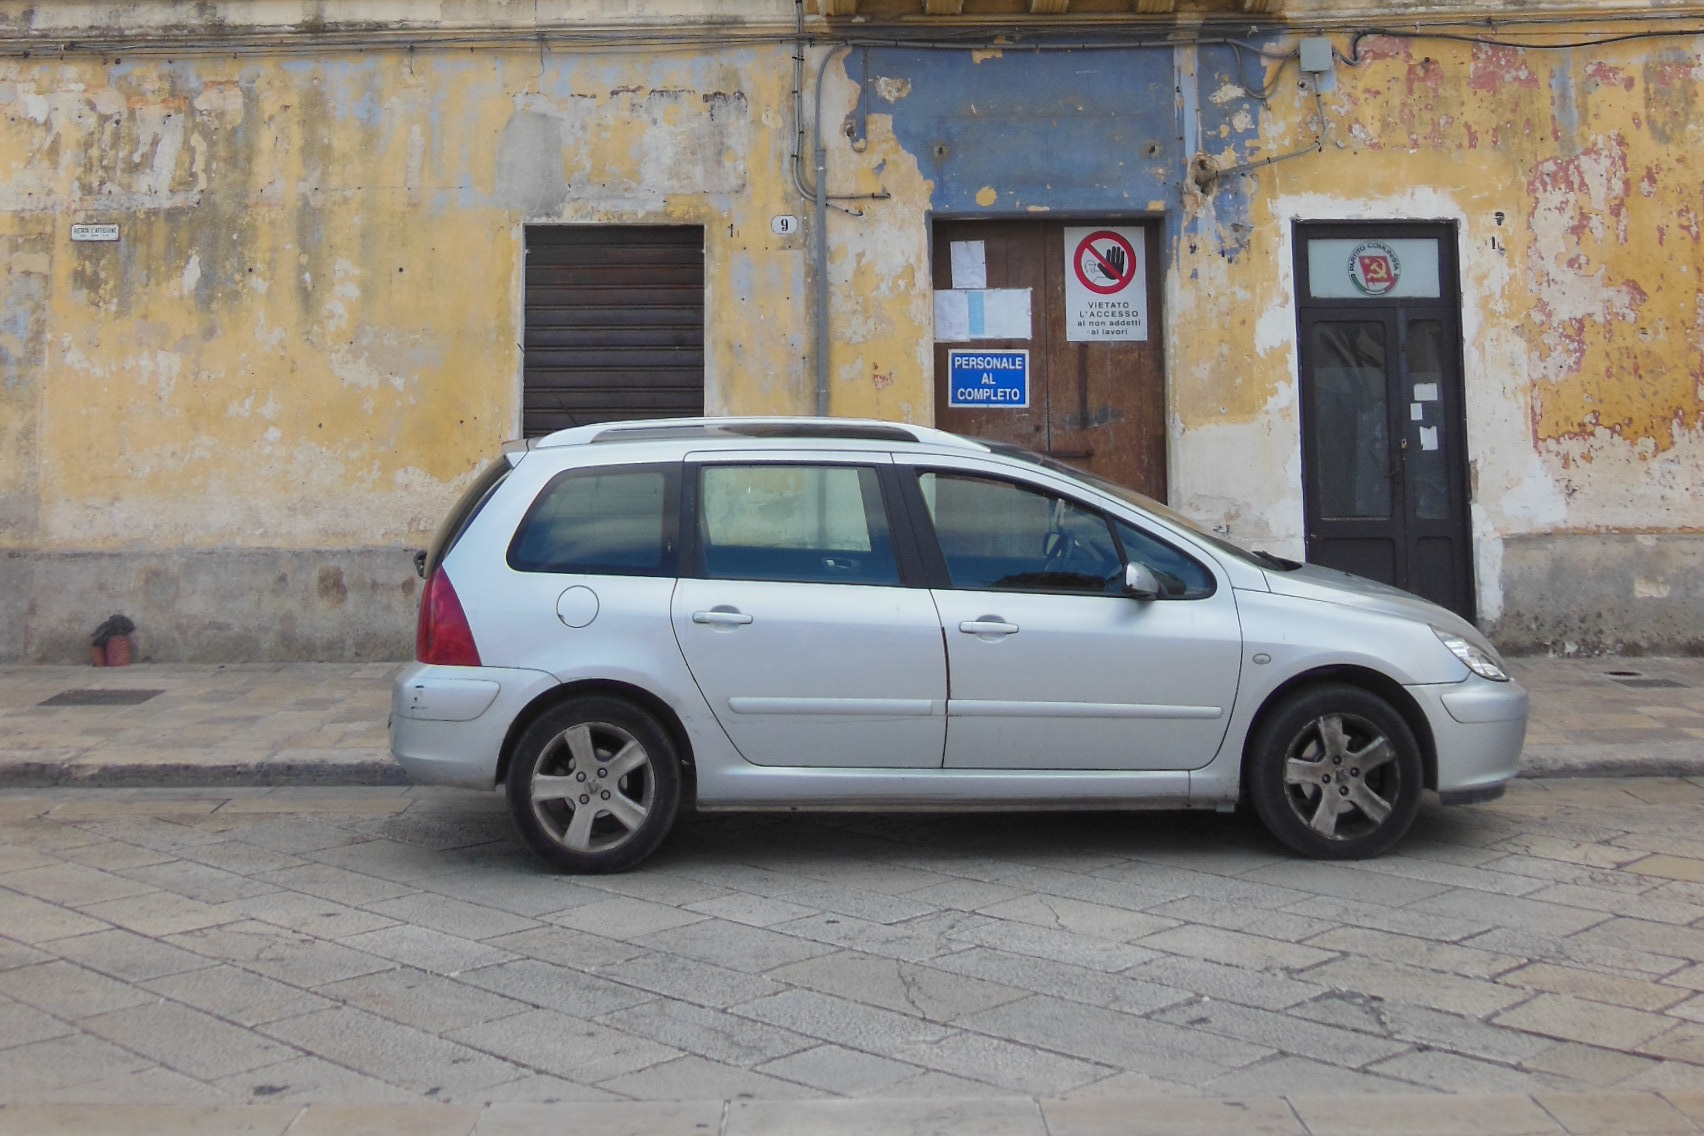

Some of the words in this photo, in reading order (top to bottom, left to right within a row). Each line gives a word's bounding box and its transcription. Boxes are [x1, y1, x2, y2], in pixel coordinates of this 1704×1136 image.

[780, 218, 789, 232] 9
[1349, 245, 1366, 271] PARTITO
[1367, 242, 1399, 271] COMUNISTA
[1088, 301, 1130, 309] VIETATO
[1079, 310, 1139, 318] L'ACCESSO
[954, 356, 1023, 369] PERSONALE
[981, 372, 997, 385] AL
[957, 388, 1020, 401] COMPLETO
